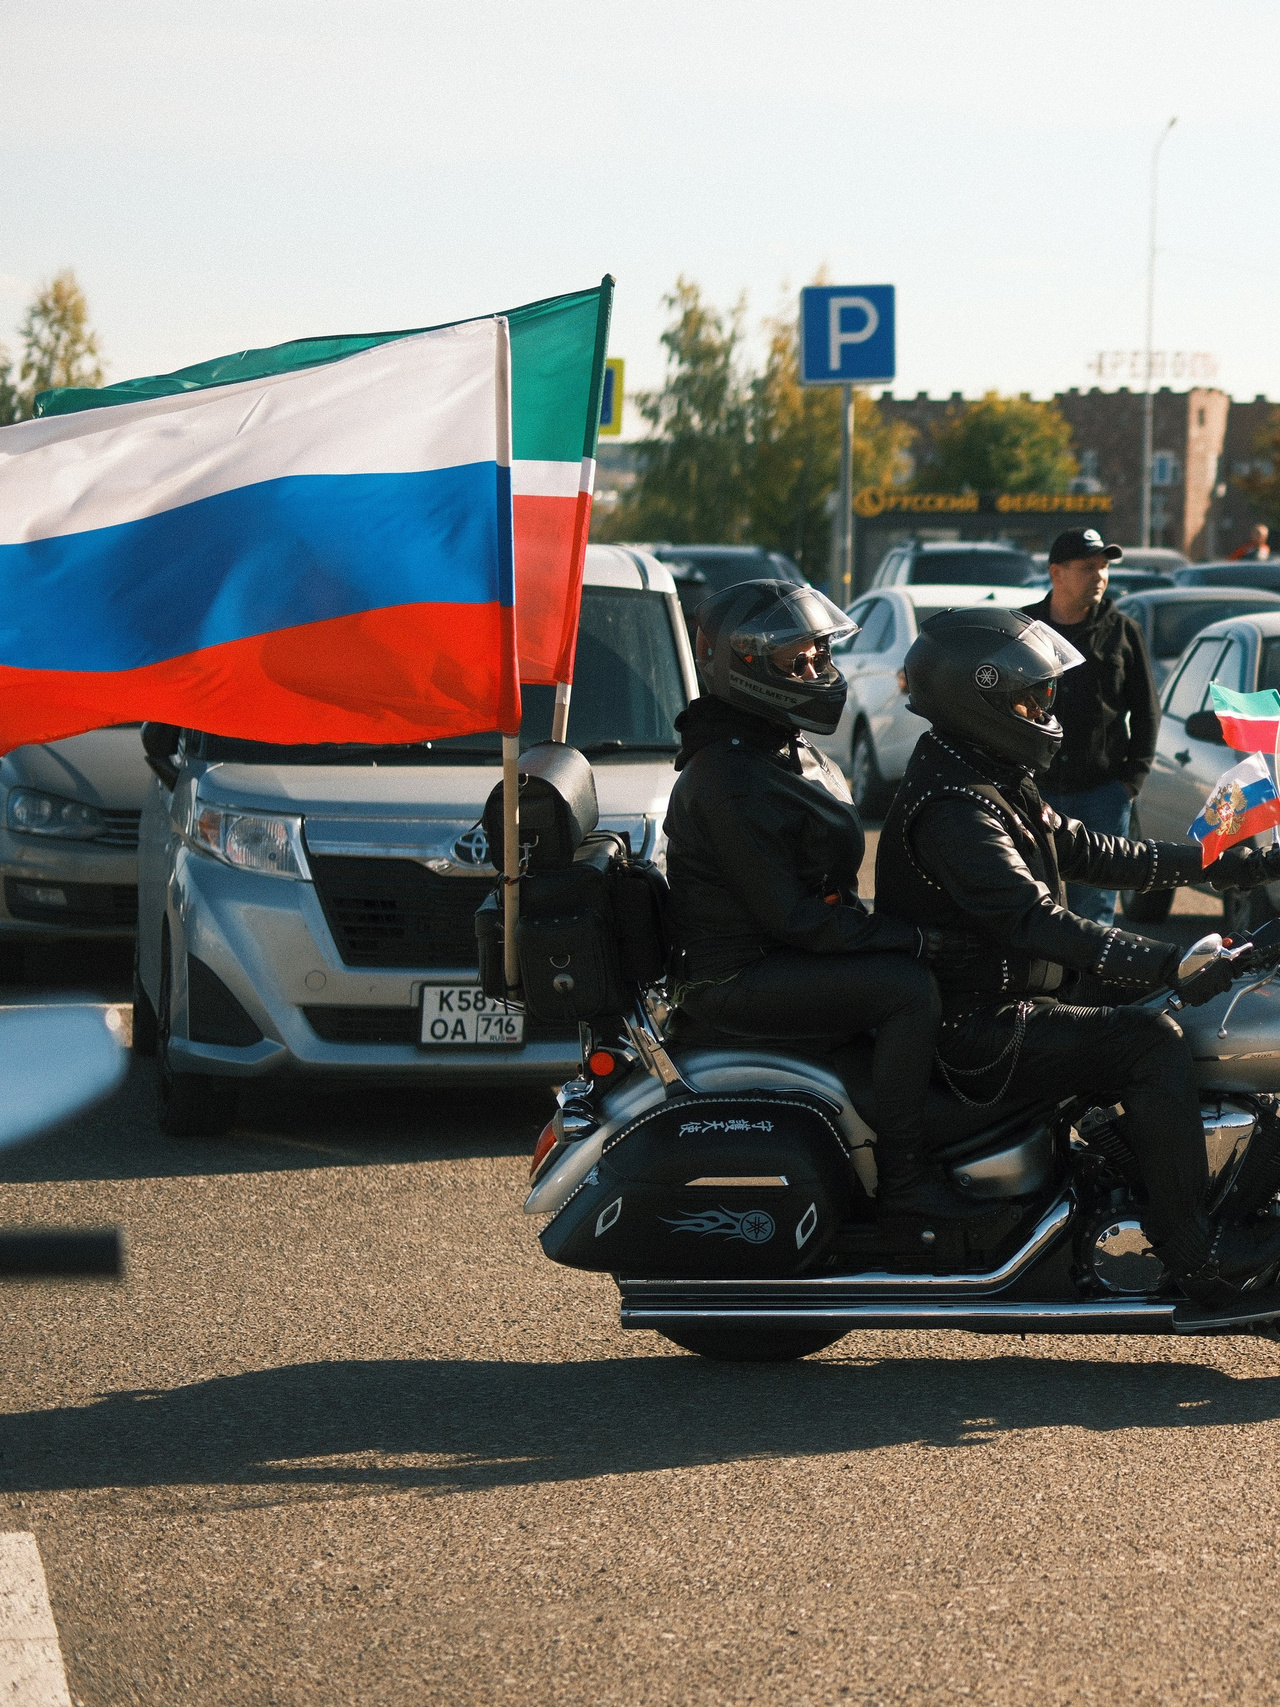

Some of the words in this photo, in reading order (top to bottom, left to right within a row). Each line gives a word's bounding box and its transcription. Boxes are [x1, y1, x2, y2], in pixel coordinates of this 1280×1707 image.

[829, 296, 879, 371] P
[430, 1018, 467, 1040] ОА
[481, 1017, 516, 1035] 716
[679, 1118, 774, 1137] 守護天使
